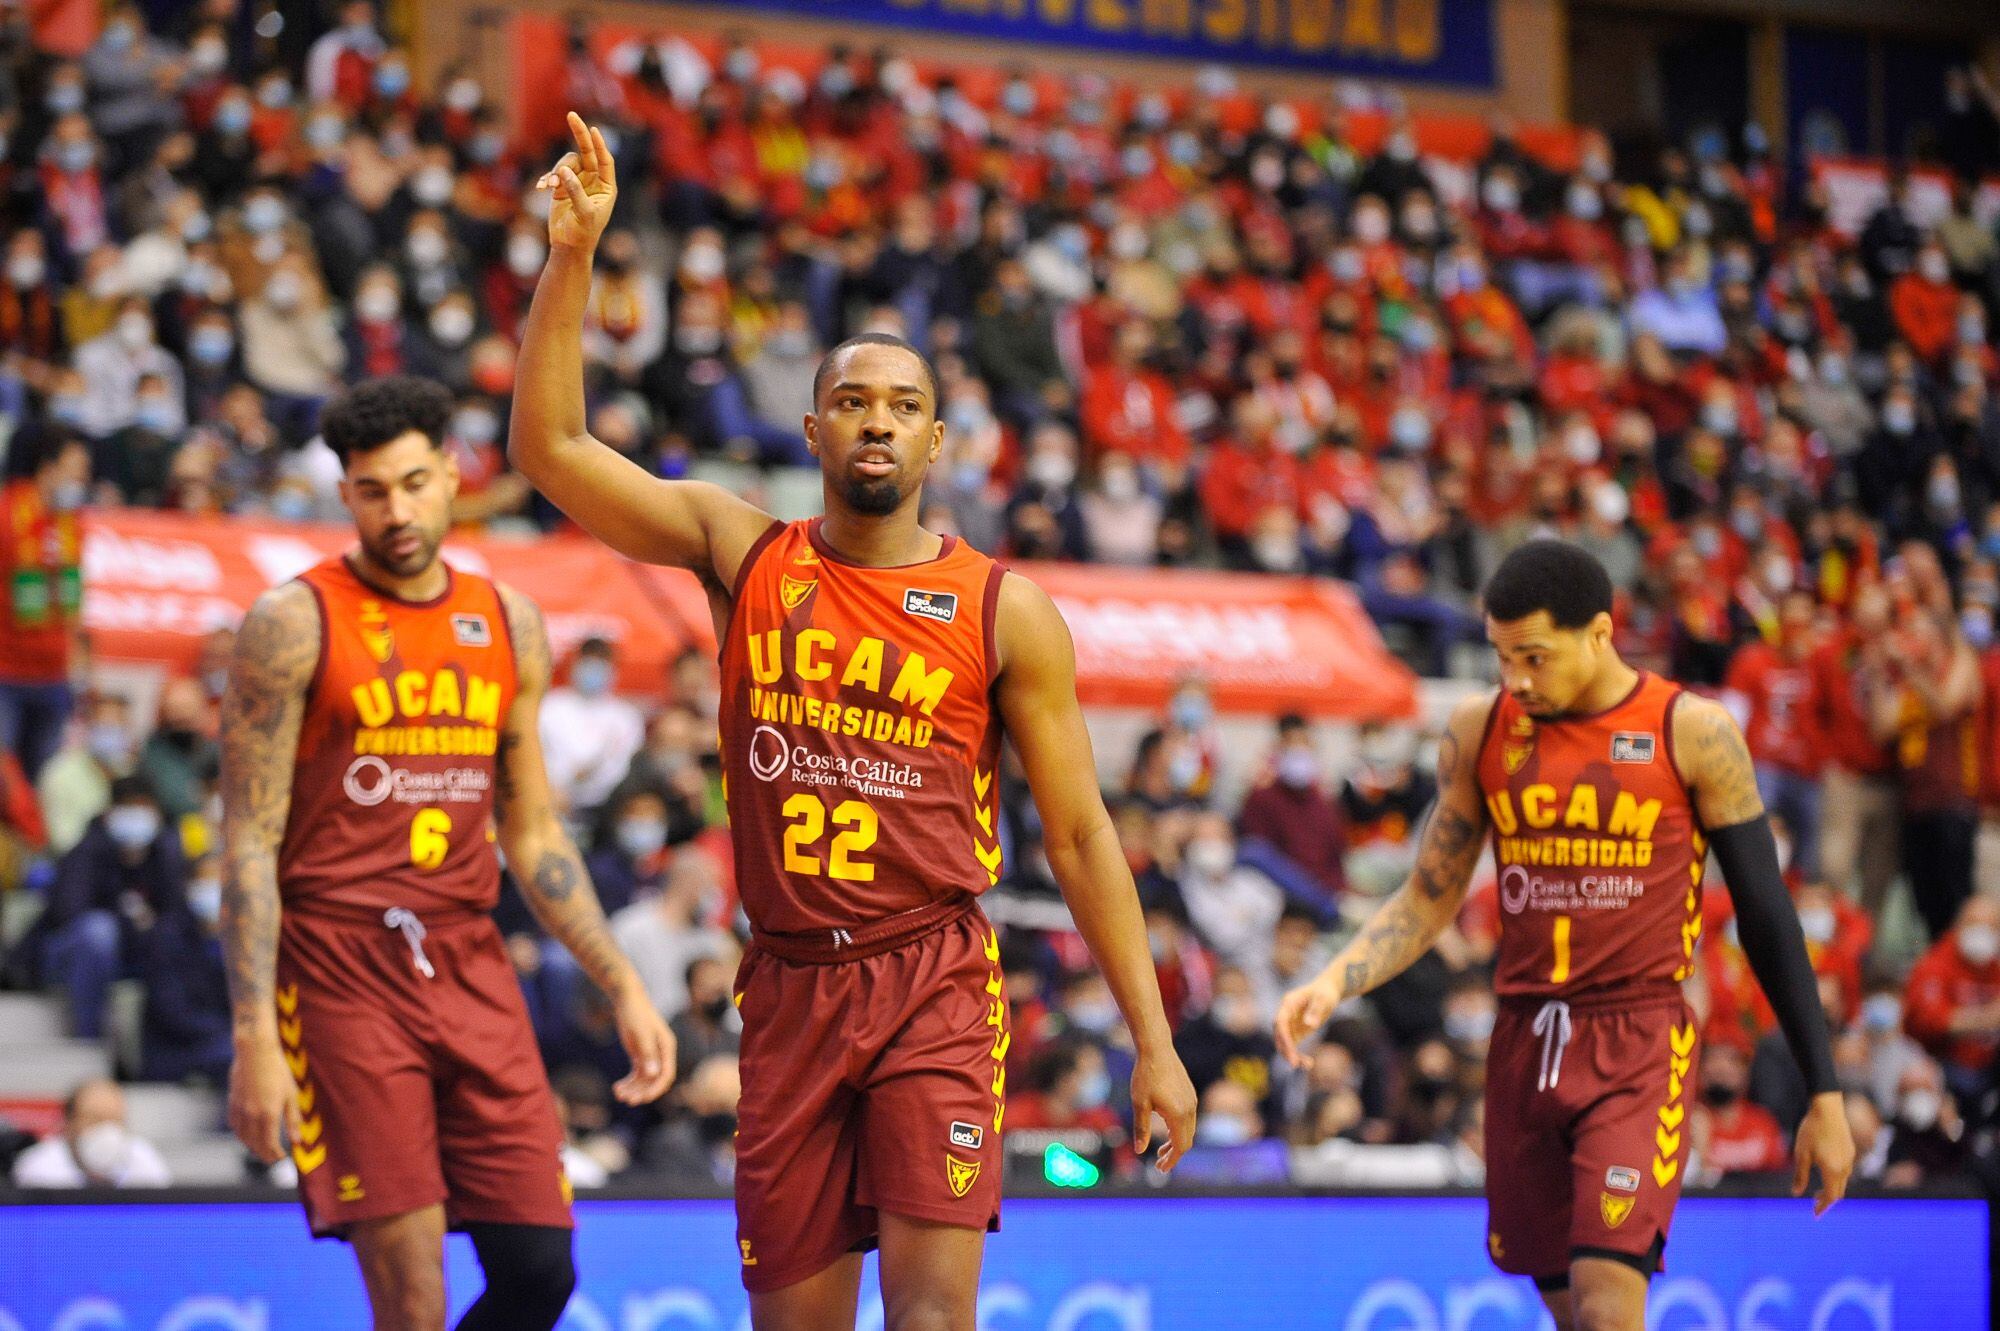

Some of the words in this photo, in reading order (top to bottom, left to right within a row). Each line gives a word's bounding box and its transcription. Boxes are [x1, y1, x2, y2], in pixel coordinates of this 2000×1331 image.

[351, 668, 502, 728] UCAM
[747, 628, 954, 717] UCAM
[749, 687, 934, 749] UNIVERSIDAD
[791, 746, 848, 774] Costa
[850, 757, 923, 788] Cálida
[791, 768, 838, 788] Región
[840, 774, 857, 788] de
[856, 780, 905, 799] Murcia
[409, 807, 452, 870] 6
[781, 793, 879, 882] 22
[1486, 783, 1663, 840] UCAM
[1500, 836, 1653, 868] UNIVERSIDAD
[1551, 915, 1572, 984] 1
[953, 1131, 975, 1144] acb
